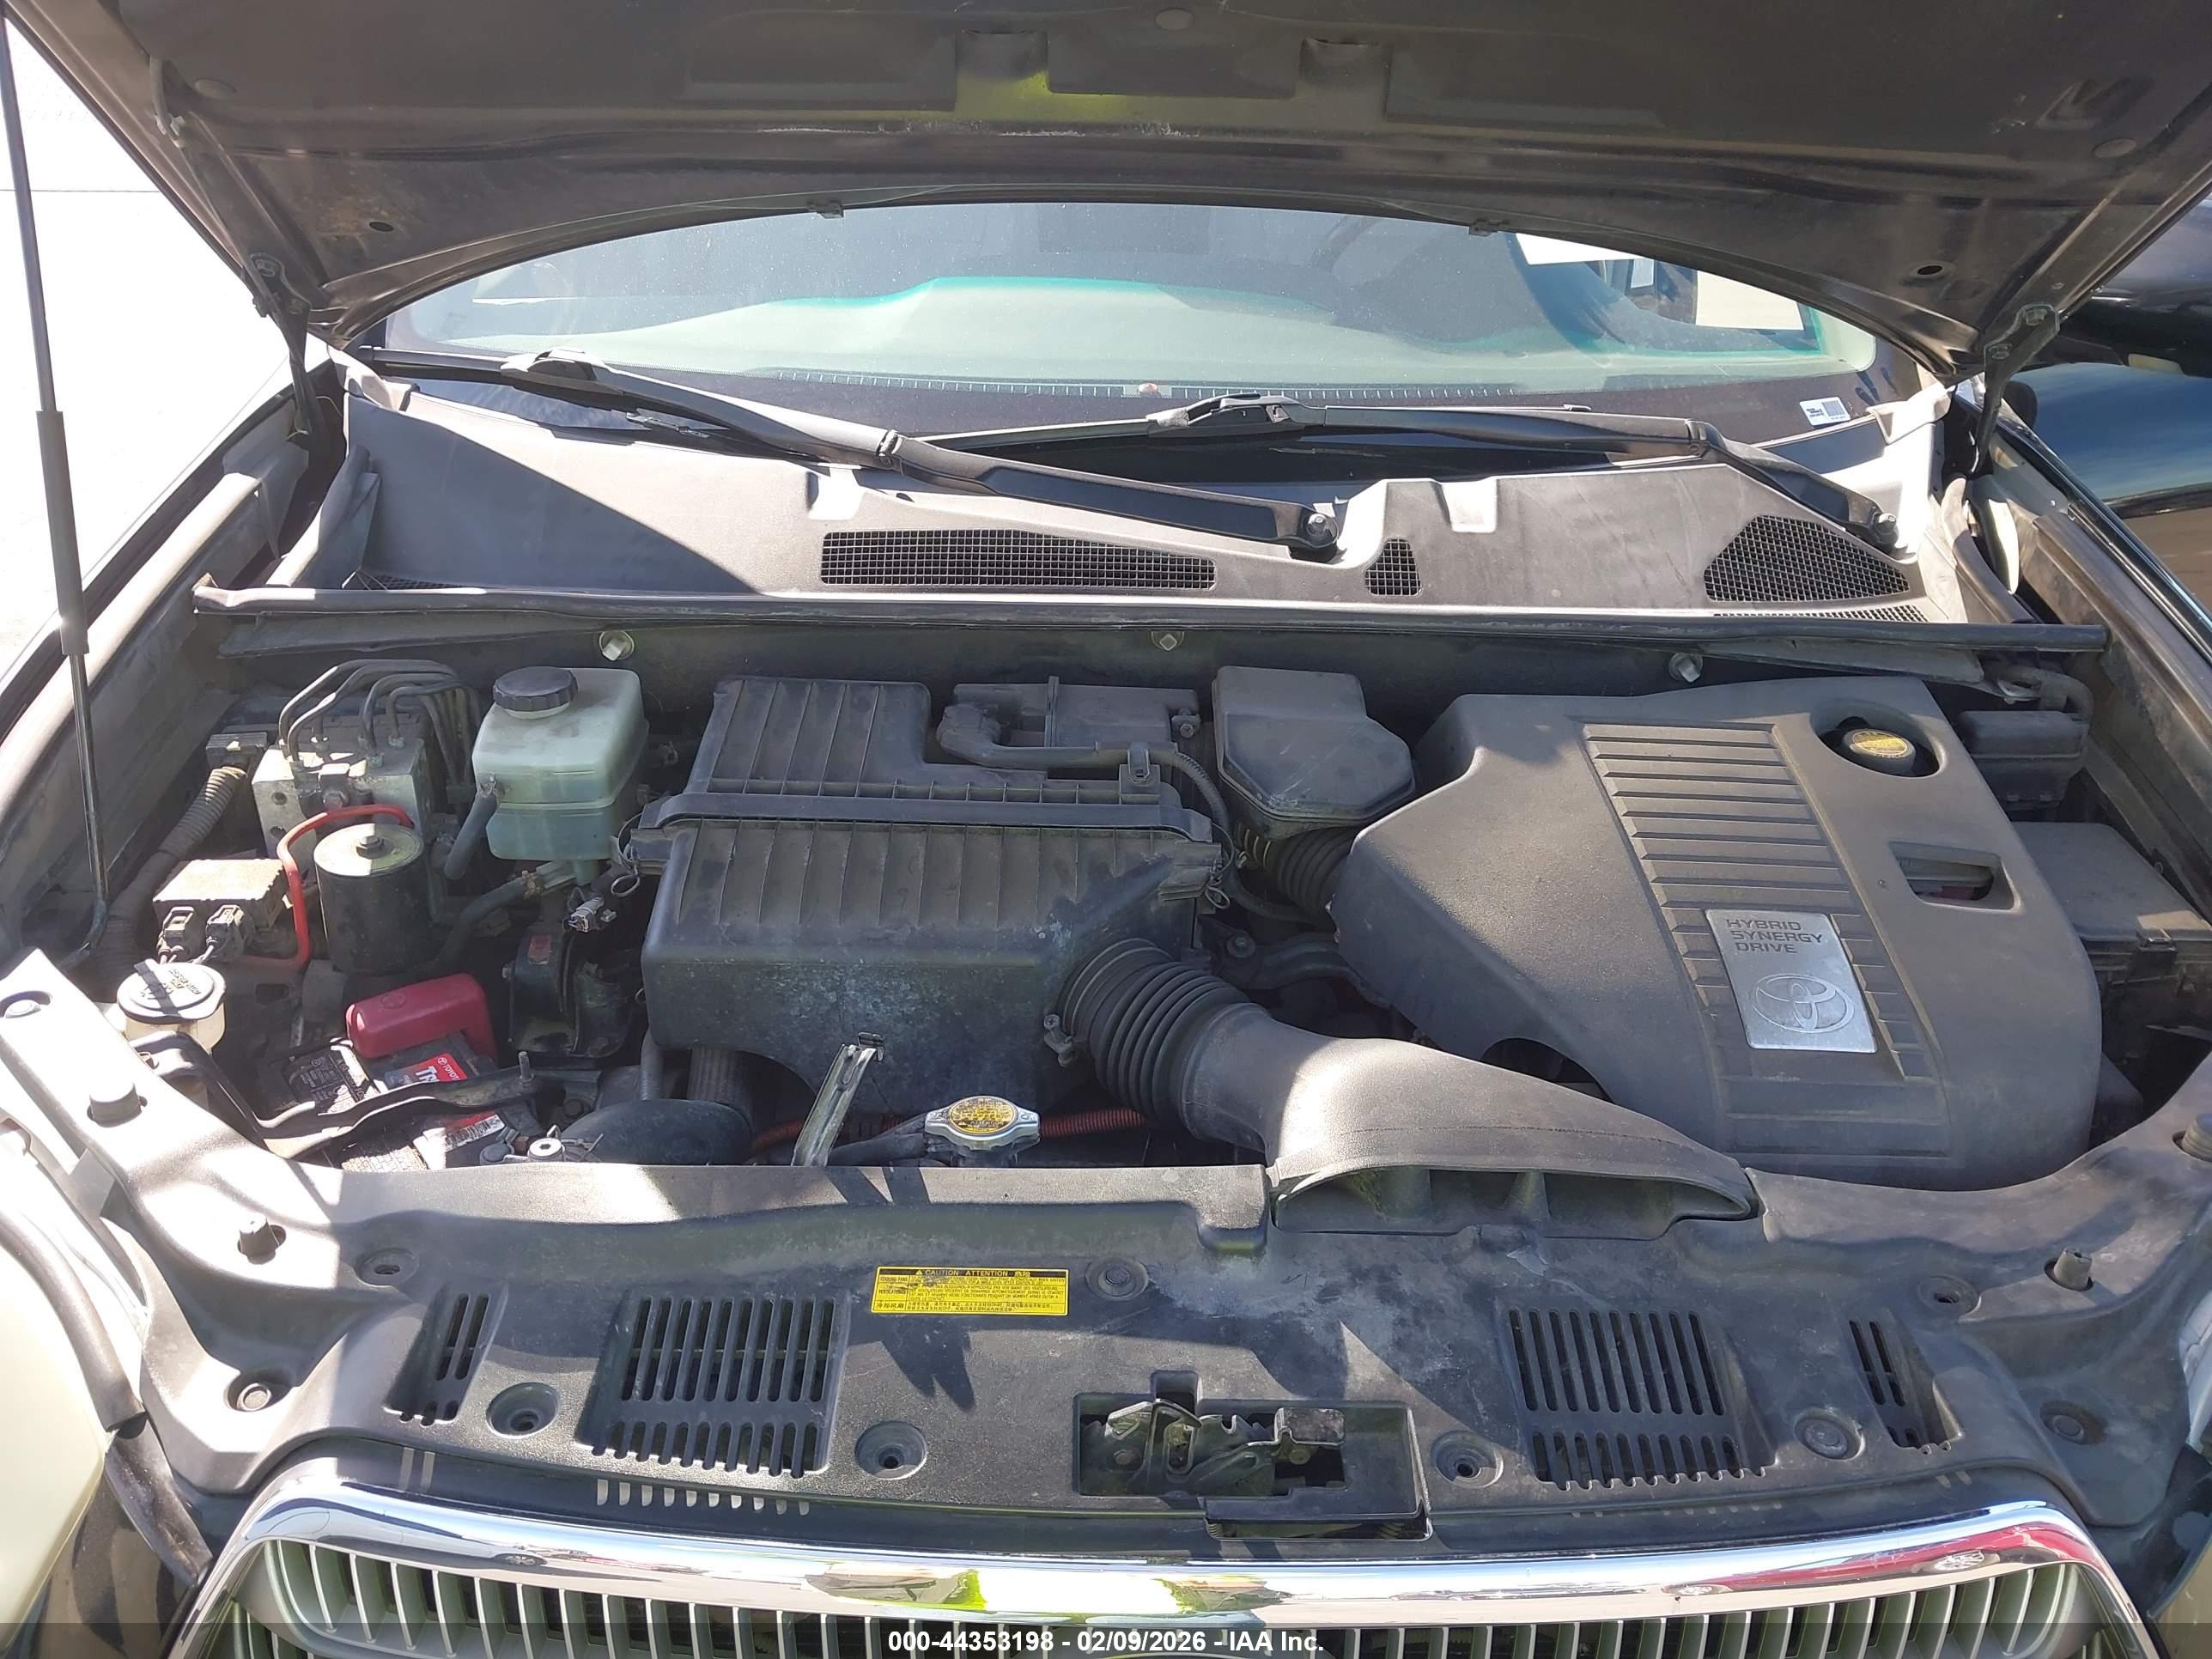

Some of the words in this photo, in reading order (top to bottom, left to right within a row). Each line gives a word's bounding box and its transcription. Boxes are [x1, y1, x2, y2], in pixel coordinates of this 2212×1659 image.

[1726, 919, 1802, 930] HYBRID
[1730, 930, 1823, 943] SYNERGY
[1735, 942, 1797, 953] DRIVE
[443, 1064, 461, 1081] TOYOT
